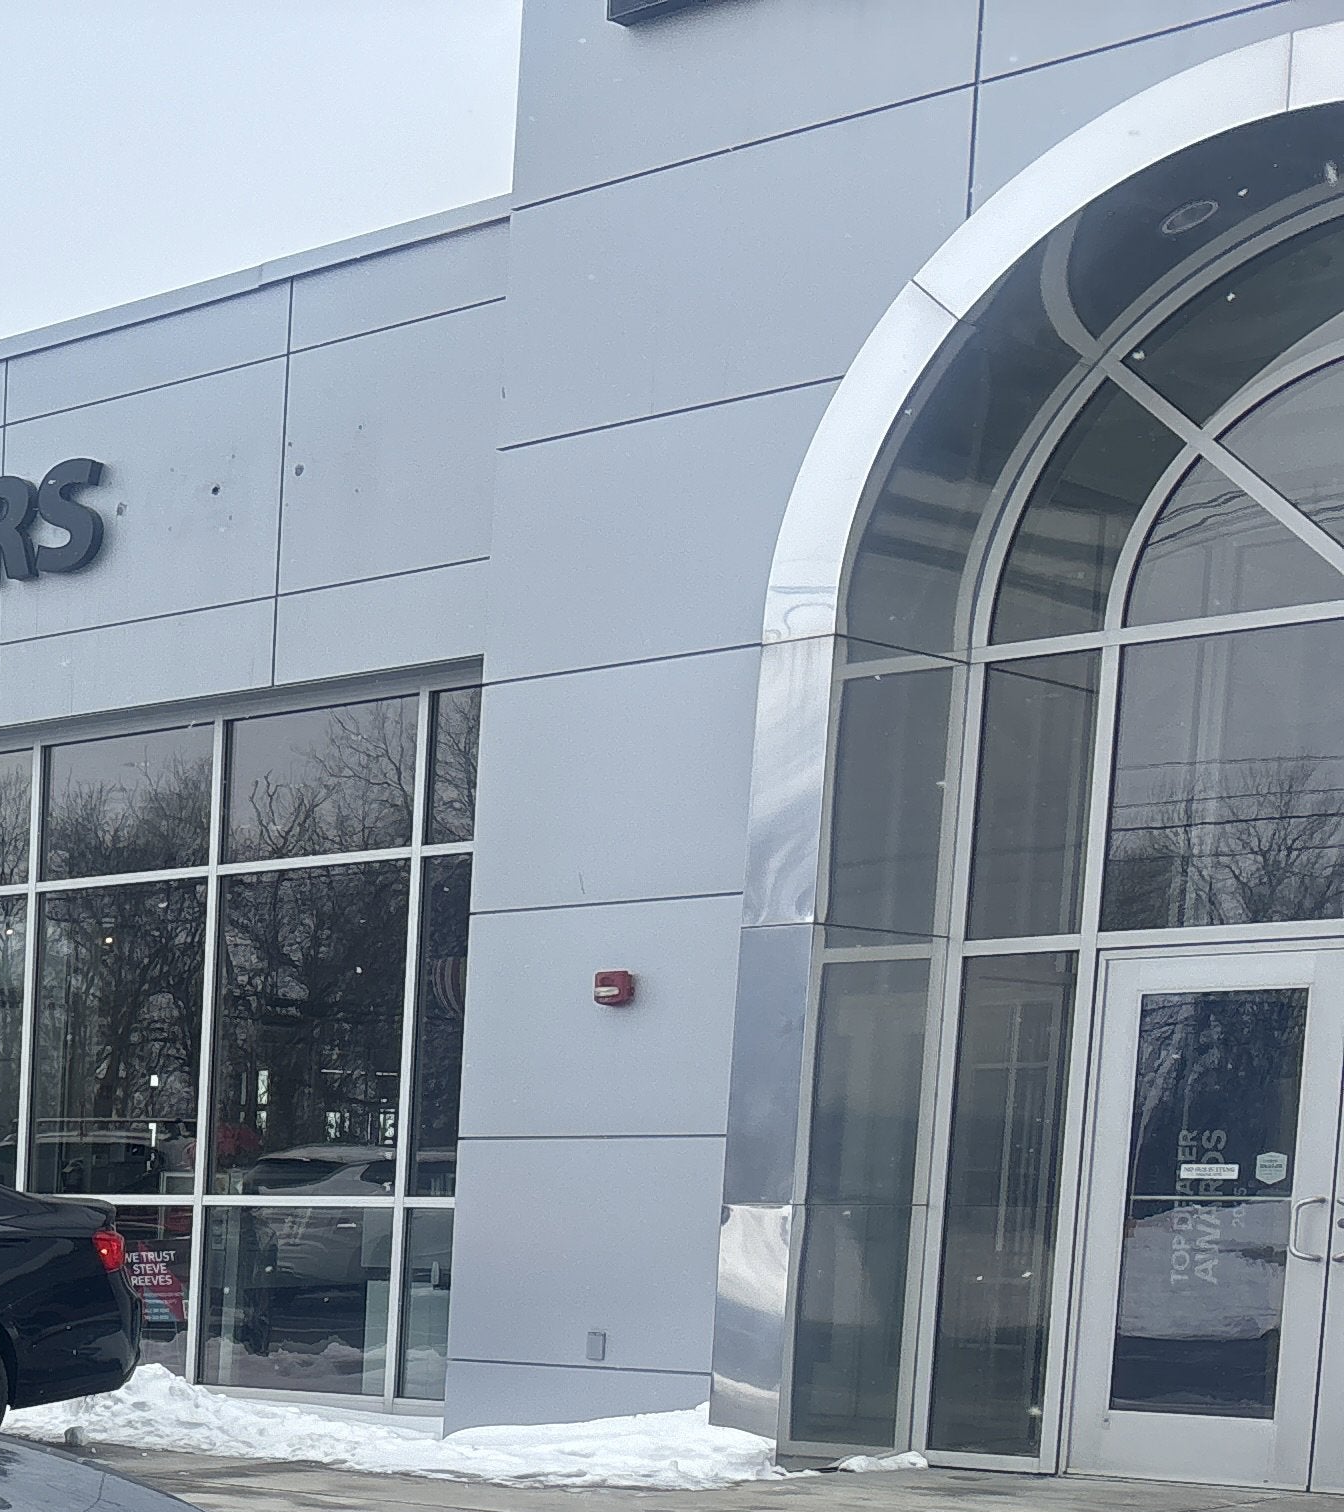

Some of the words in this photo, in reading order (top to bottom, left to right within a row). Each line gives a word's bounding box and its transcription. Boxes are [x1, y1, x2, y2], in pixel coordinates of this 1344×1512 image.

[1174, 1129, 1198, 1231] DEAER
[140, 1251, 176, 1262] TRUST
[1170, 1234, 1190, 1285] TOP
[132, 1263, 167, 1275] STEVE
[131, 1275, 173, 1286] REEVES
